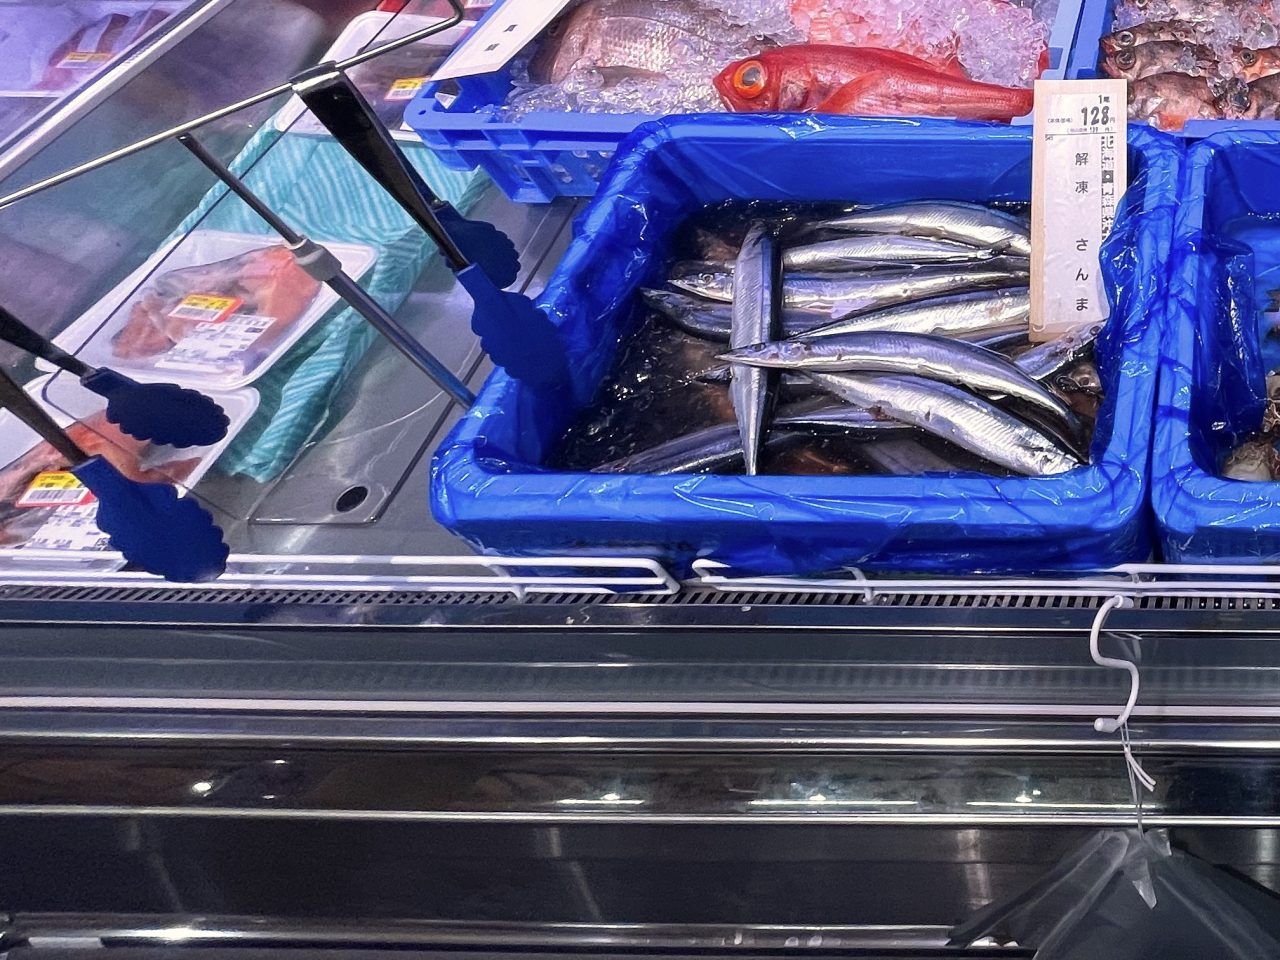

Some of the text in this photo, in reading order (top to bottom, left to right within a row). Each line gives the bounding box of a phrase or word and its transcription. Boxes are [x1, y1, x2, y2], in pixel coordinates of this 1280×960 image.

[1075, 152, 1089, 312] 解凍 さんま
